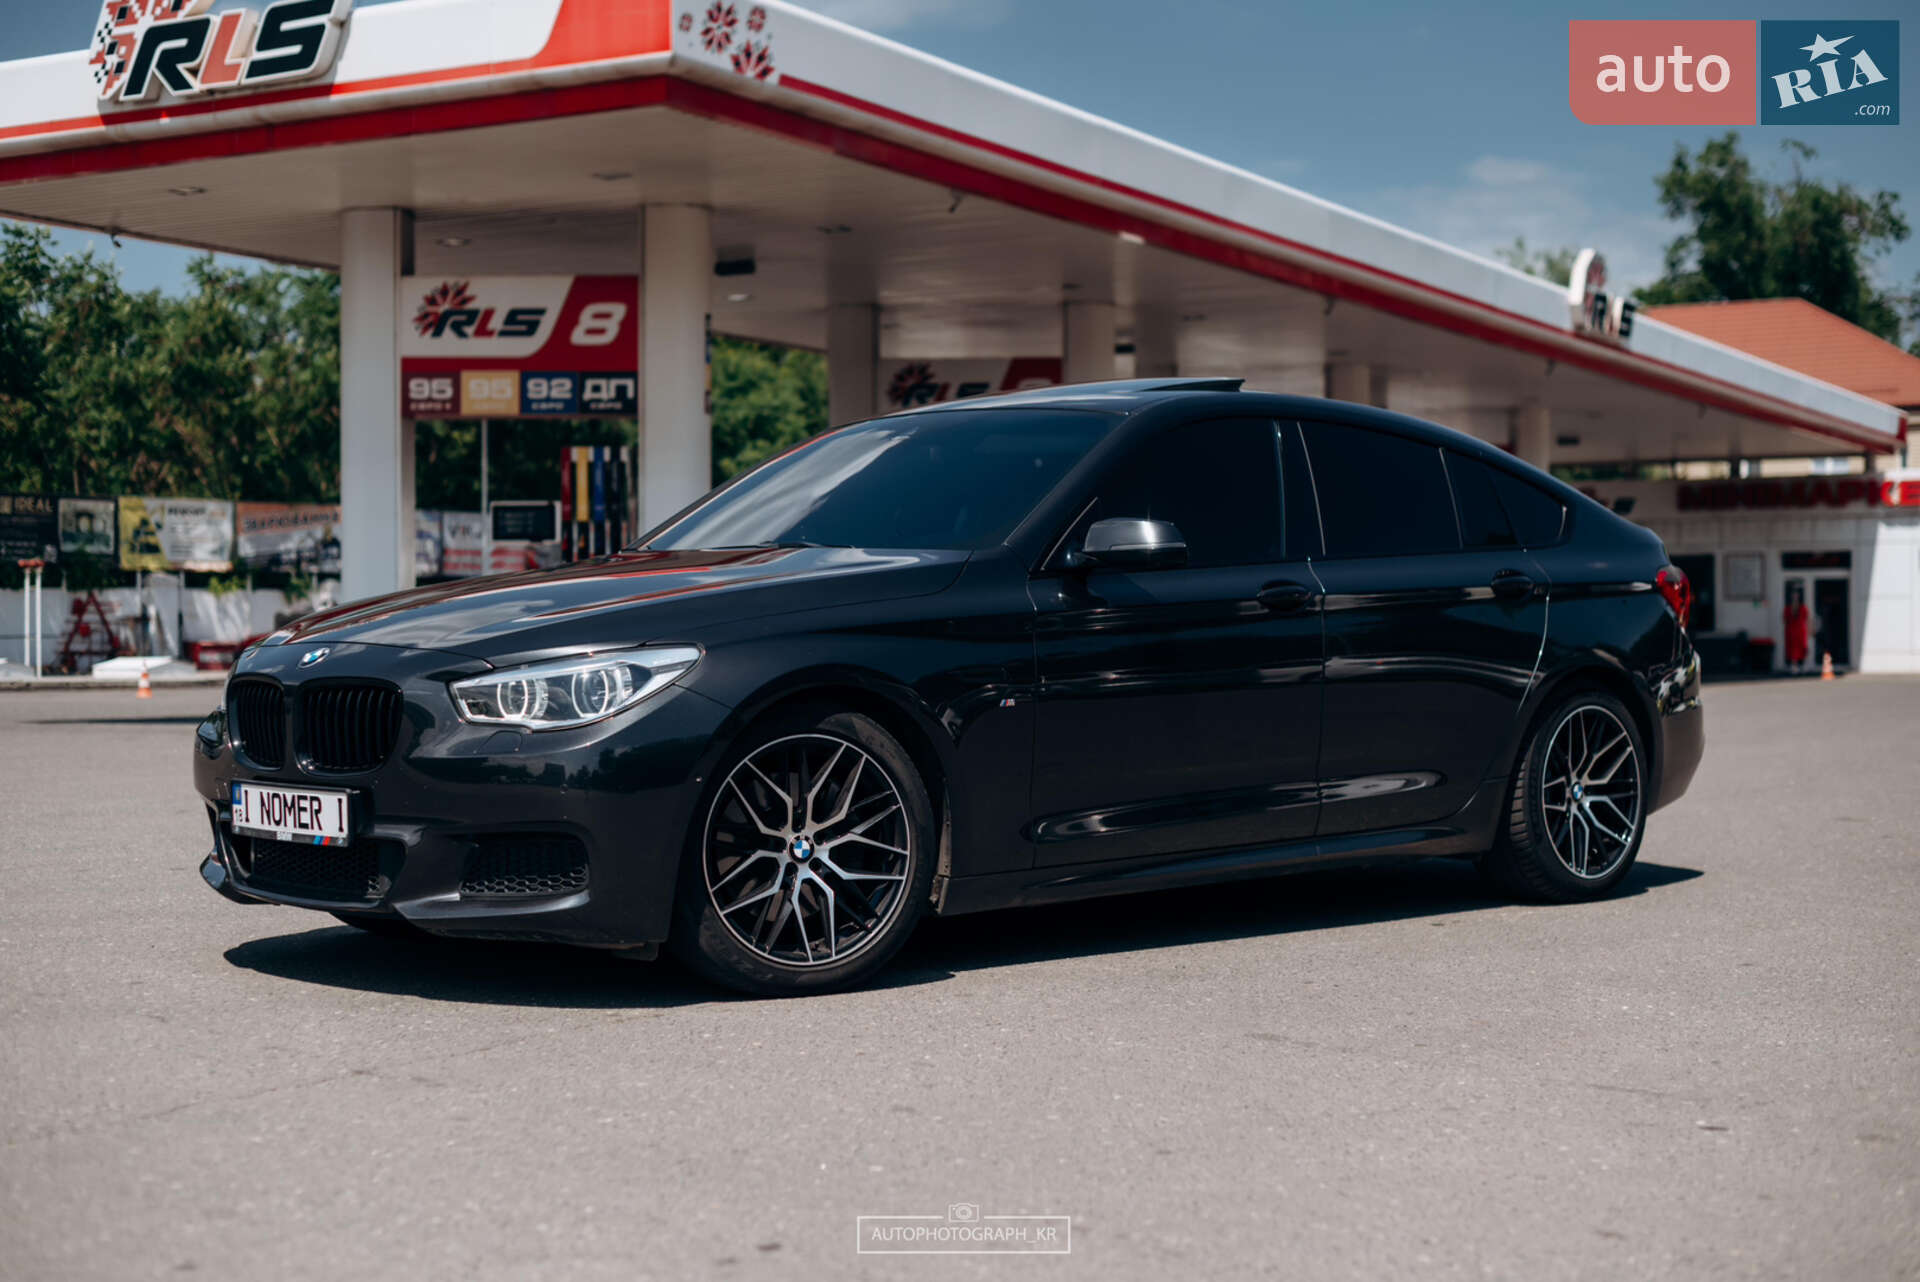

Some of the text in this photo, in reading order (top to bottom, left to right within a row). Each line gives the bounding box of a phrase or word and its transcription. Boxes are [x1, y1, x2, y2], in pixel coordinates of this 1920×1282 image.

[123, 0, 336, 97] RLS
[430, 302, 627, 346] RLS 8
[409, 377, 573, 399] 95 95 92
[582, 377, 635, 401] ДП
[259, 791, 323, 831] NOMER
